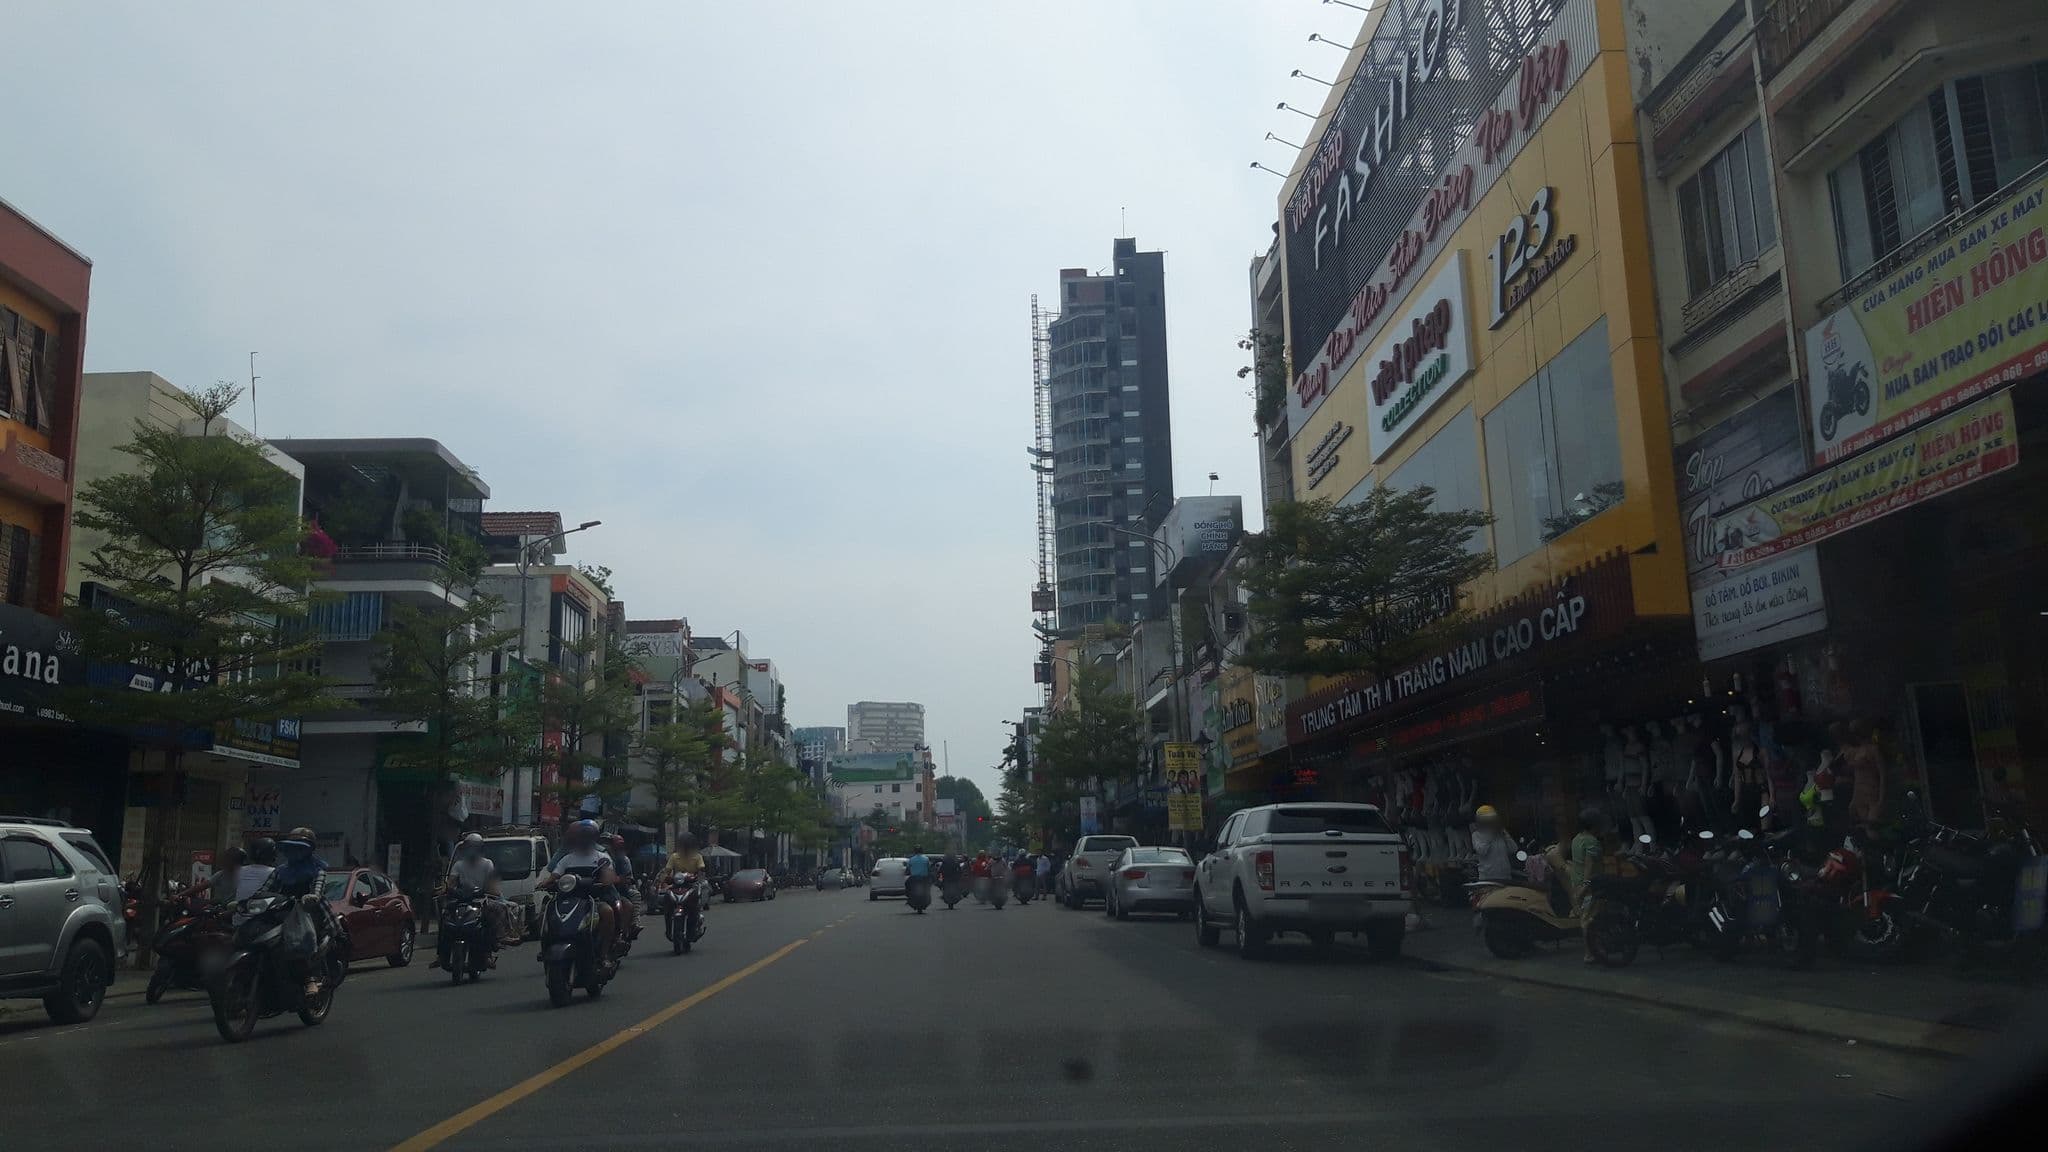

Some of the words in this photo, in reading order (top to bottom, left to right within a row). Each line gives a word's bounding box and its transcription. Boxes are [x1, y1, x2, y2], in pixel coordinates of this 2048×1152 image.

[1314, 0, 1461, 270] FASHIO
[1488, 186, 1553, 331] 123
[1928, 246, 1956, 273] MUA
[1990, 212, 2009, 235] XE
[1885, 374, 1911, 401] MUA
[2037, 300, 2048, 322] L
[1382, 353, 1451, 432] COLLECTION
[1686, 447, 1724, 493] Shop
[1772, 563, 1800, 586] BIKINI
[1300, 702, 1337, 734] TRUNG
[1337, 687, 1362, 721] TÂM
[1364, 677, 1393, 711] THI
[1394, 655, 1446, 699] TRANG
[1448, 637, 1488, 679] NAM
[1492, 617, 1534, 660] CAO
[1539, 577, 1586, 641] CẤP
[1279, 880, 1396, 888] RANGER
